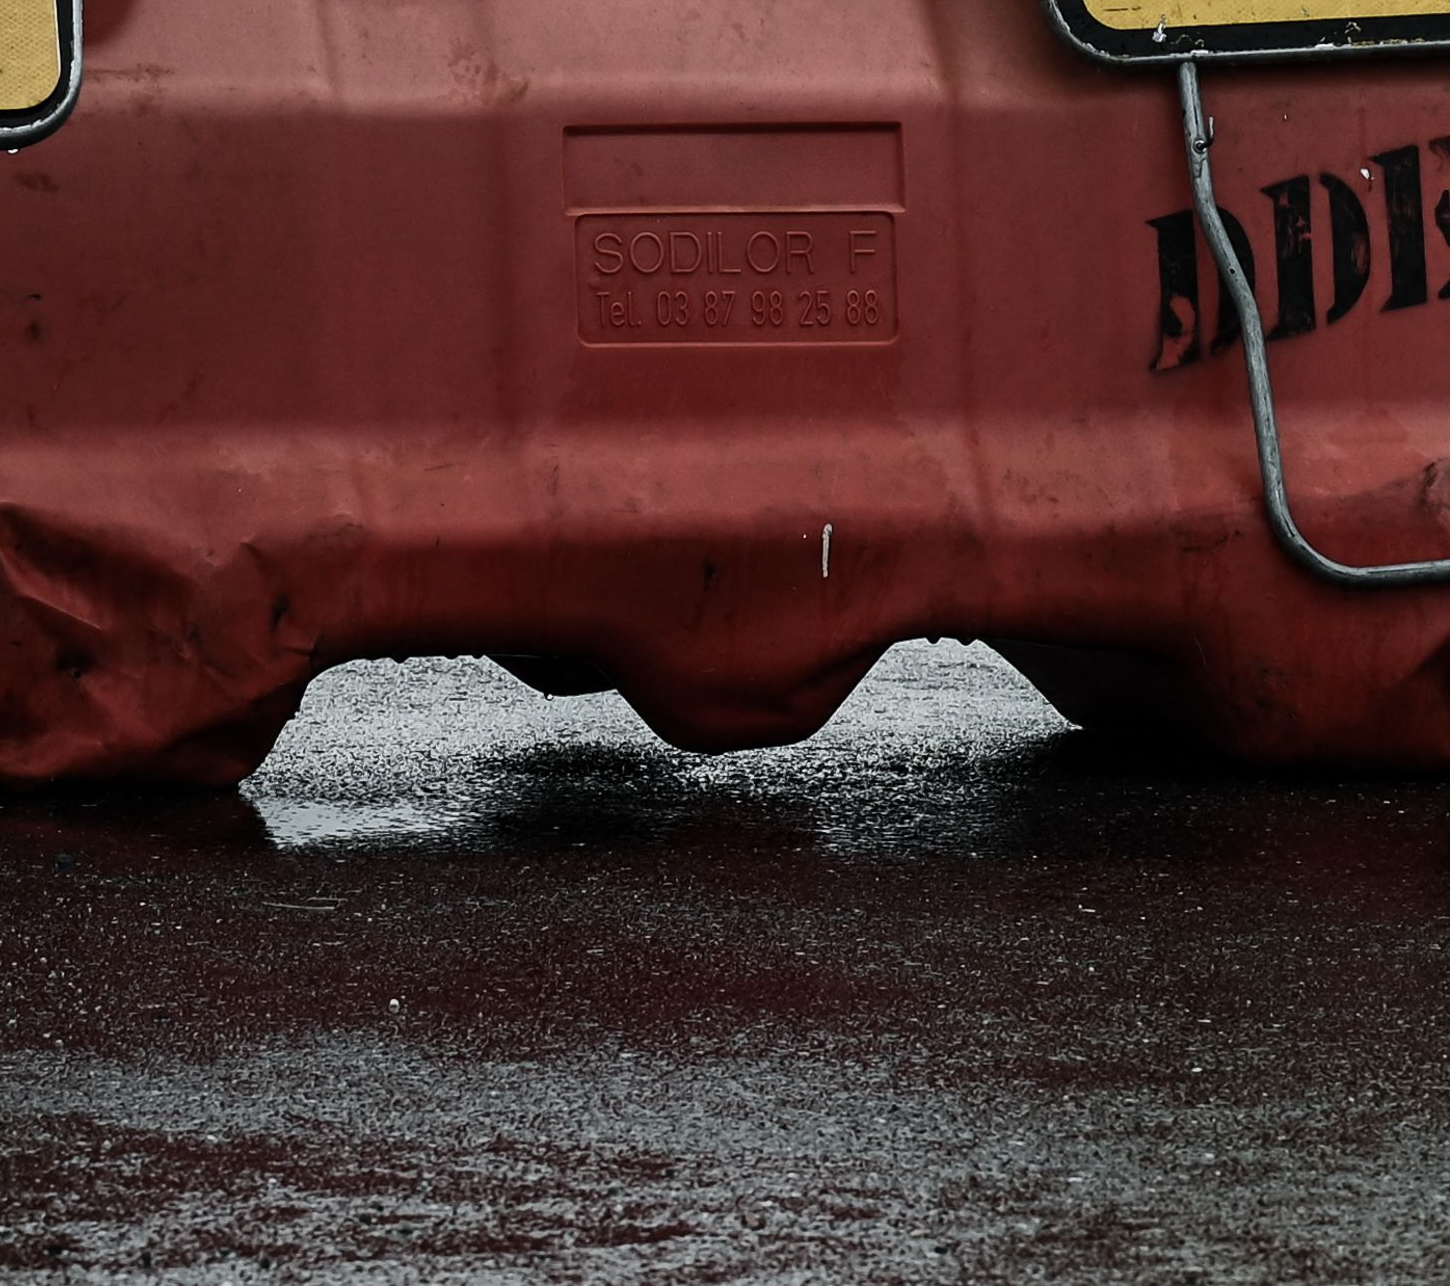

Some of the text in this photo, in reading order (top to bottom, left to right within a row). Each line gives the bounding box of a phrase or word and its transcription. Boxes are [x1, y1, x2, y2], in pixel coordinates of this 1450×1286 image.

[592, 230, 878, 274] SODILOR F
[595, 289, 880, 327] Tel. 03 87 98 25 88
